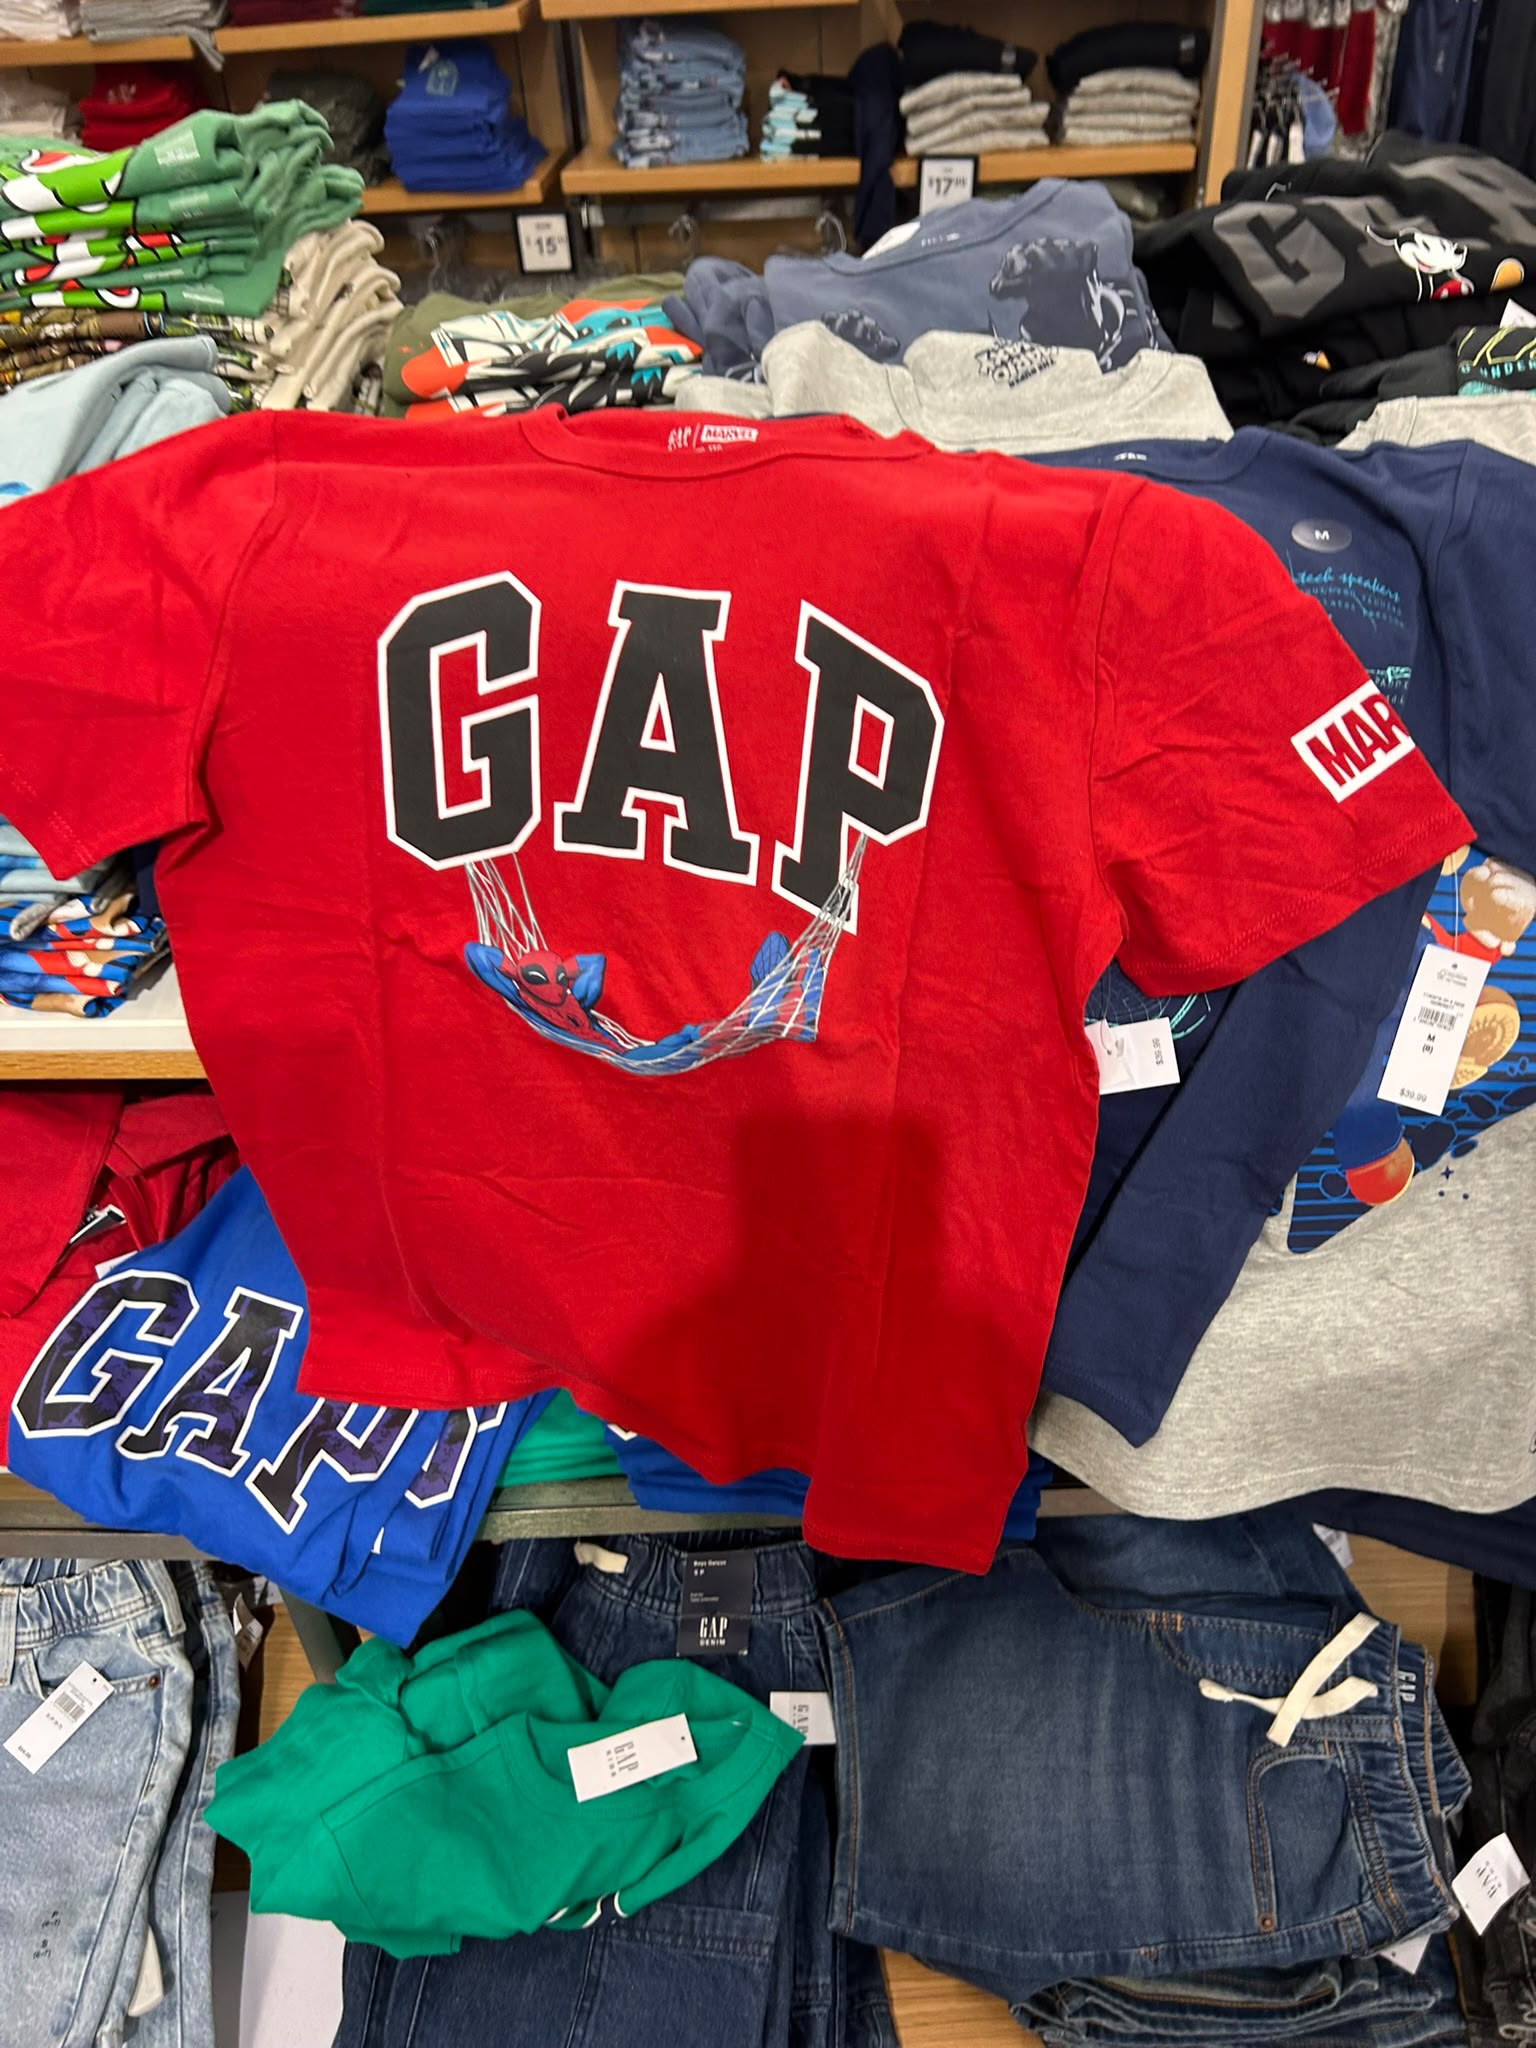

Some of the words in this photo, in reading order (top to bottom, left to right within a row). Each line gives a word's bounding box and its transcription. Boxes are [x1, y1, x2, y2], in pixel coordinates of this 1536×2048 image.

[1314, 529, 1330, 540] M
[377, 570, 945, 935] GAP
[1426, 1033, 1436, 1043] M
[12, 1269, 419, 1534] GAP
[700, 1616, 728, 1638] GAP
[700, 1638, 726, 1646] DENIM
[614, 1740, 639, 1773] GAP
